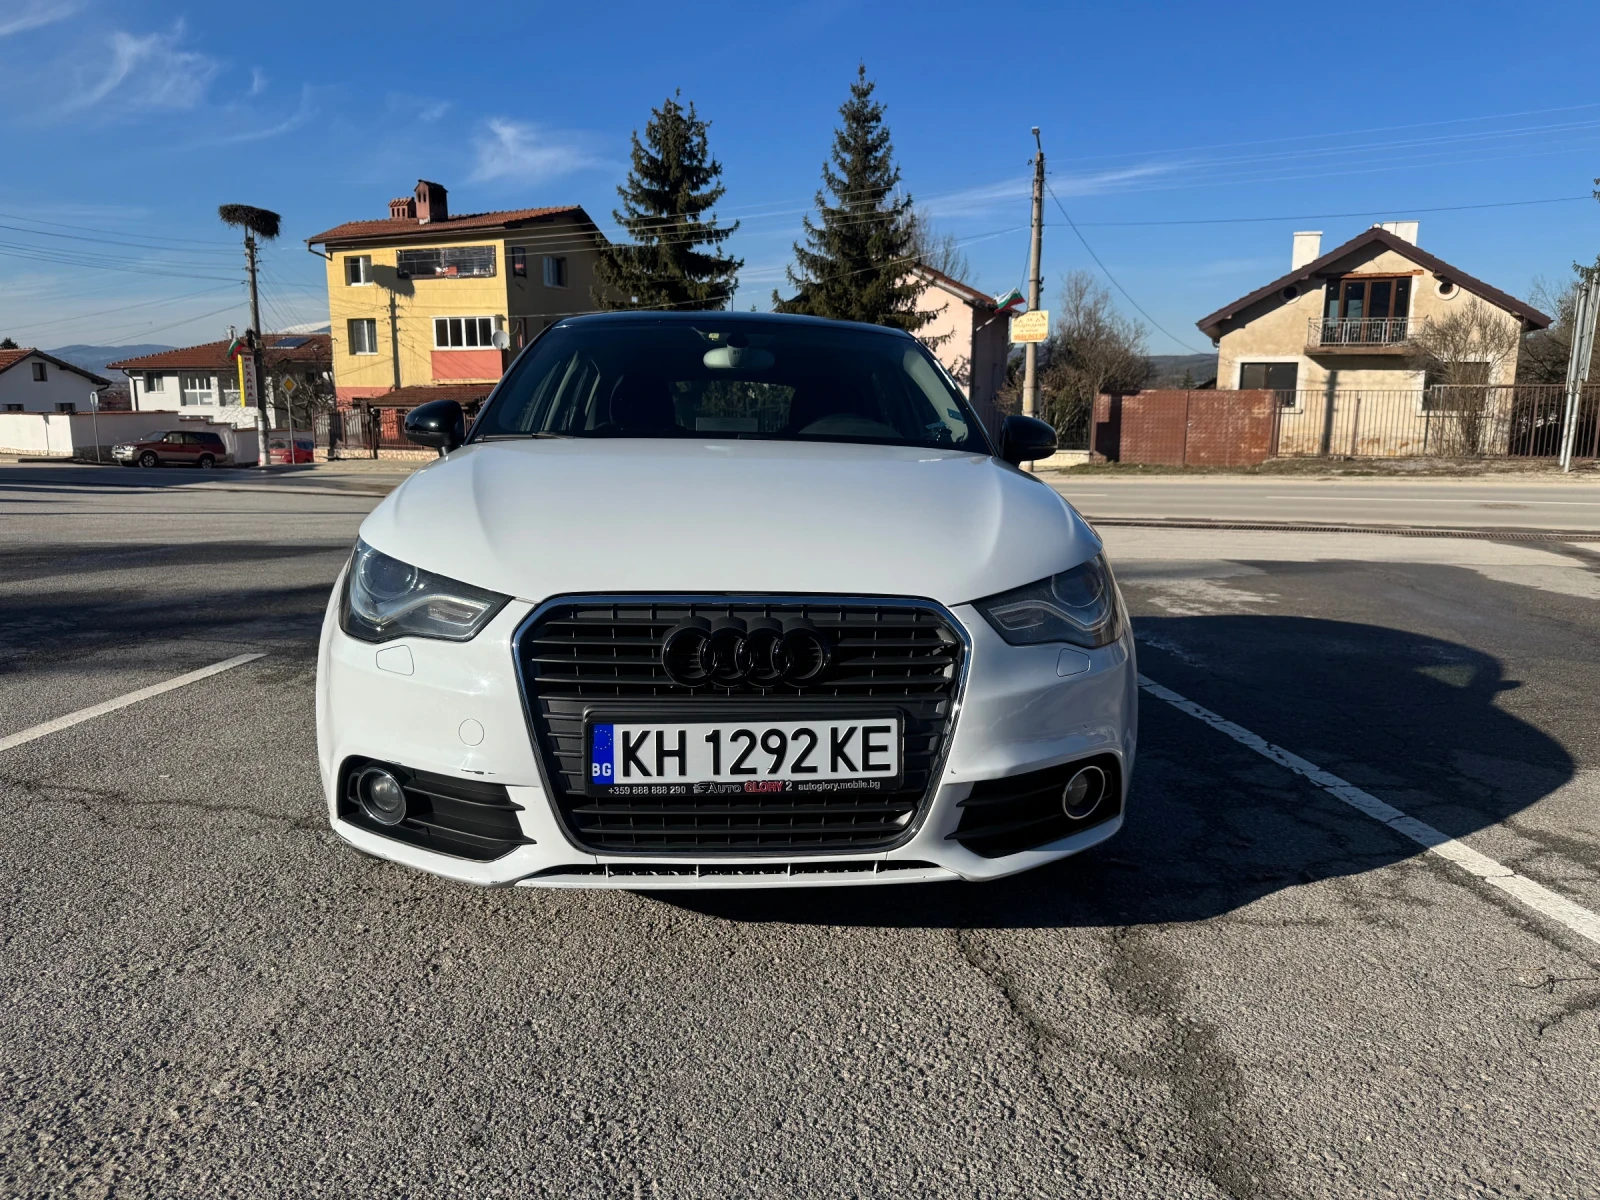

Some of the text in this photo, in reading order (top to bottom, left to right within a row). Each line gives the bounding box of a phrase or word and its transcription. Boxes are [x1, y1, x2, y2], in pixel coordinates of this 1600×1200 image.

[244, 357, 253, 397] МЕХАНА
[621, 725, 891, 777] KH 1292 KE
[592, 762, 612, 777] BG
[608, 786, 631, 795] +359
[632, 786, 649, 795] 888
[651, 786, 668, 795] 888
[669, 785, 686, 795] 290
[744, 780, 784, 793] GLORY
[785, 781, 793, 792] 2
[798, 780, 881, 792] autoglory.mobile.bg
